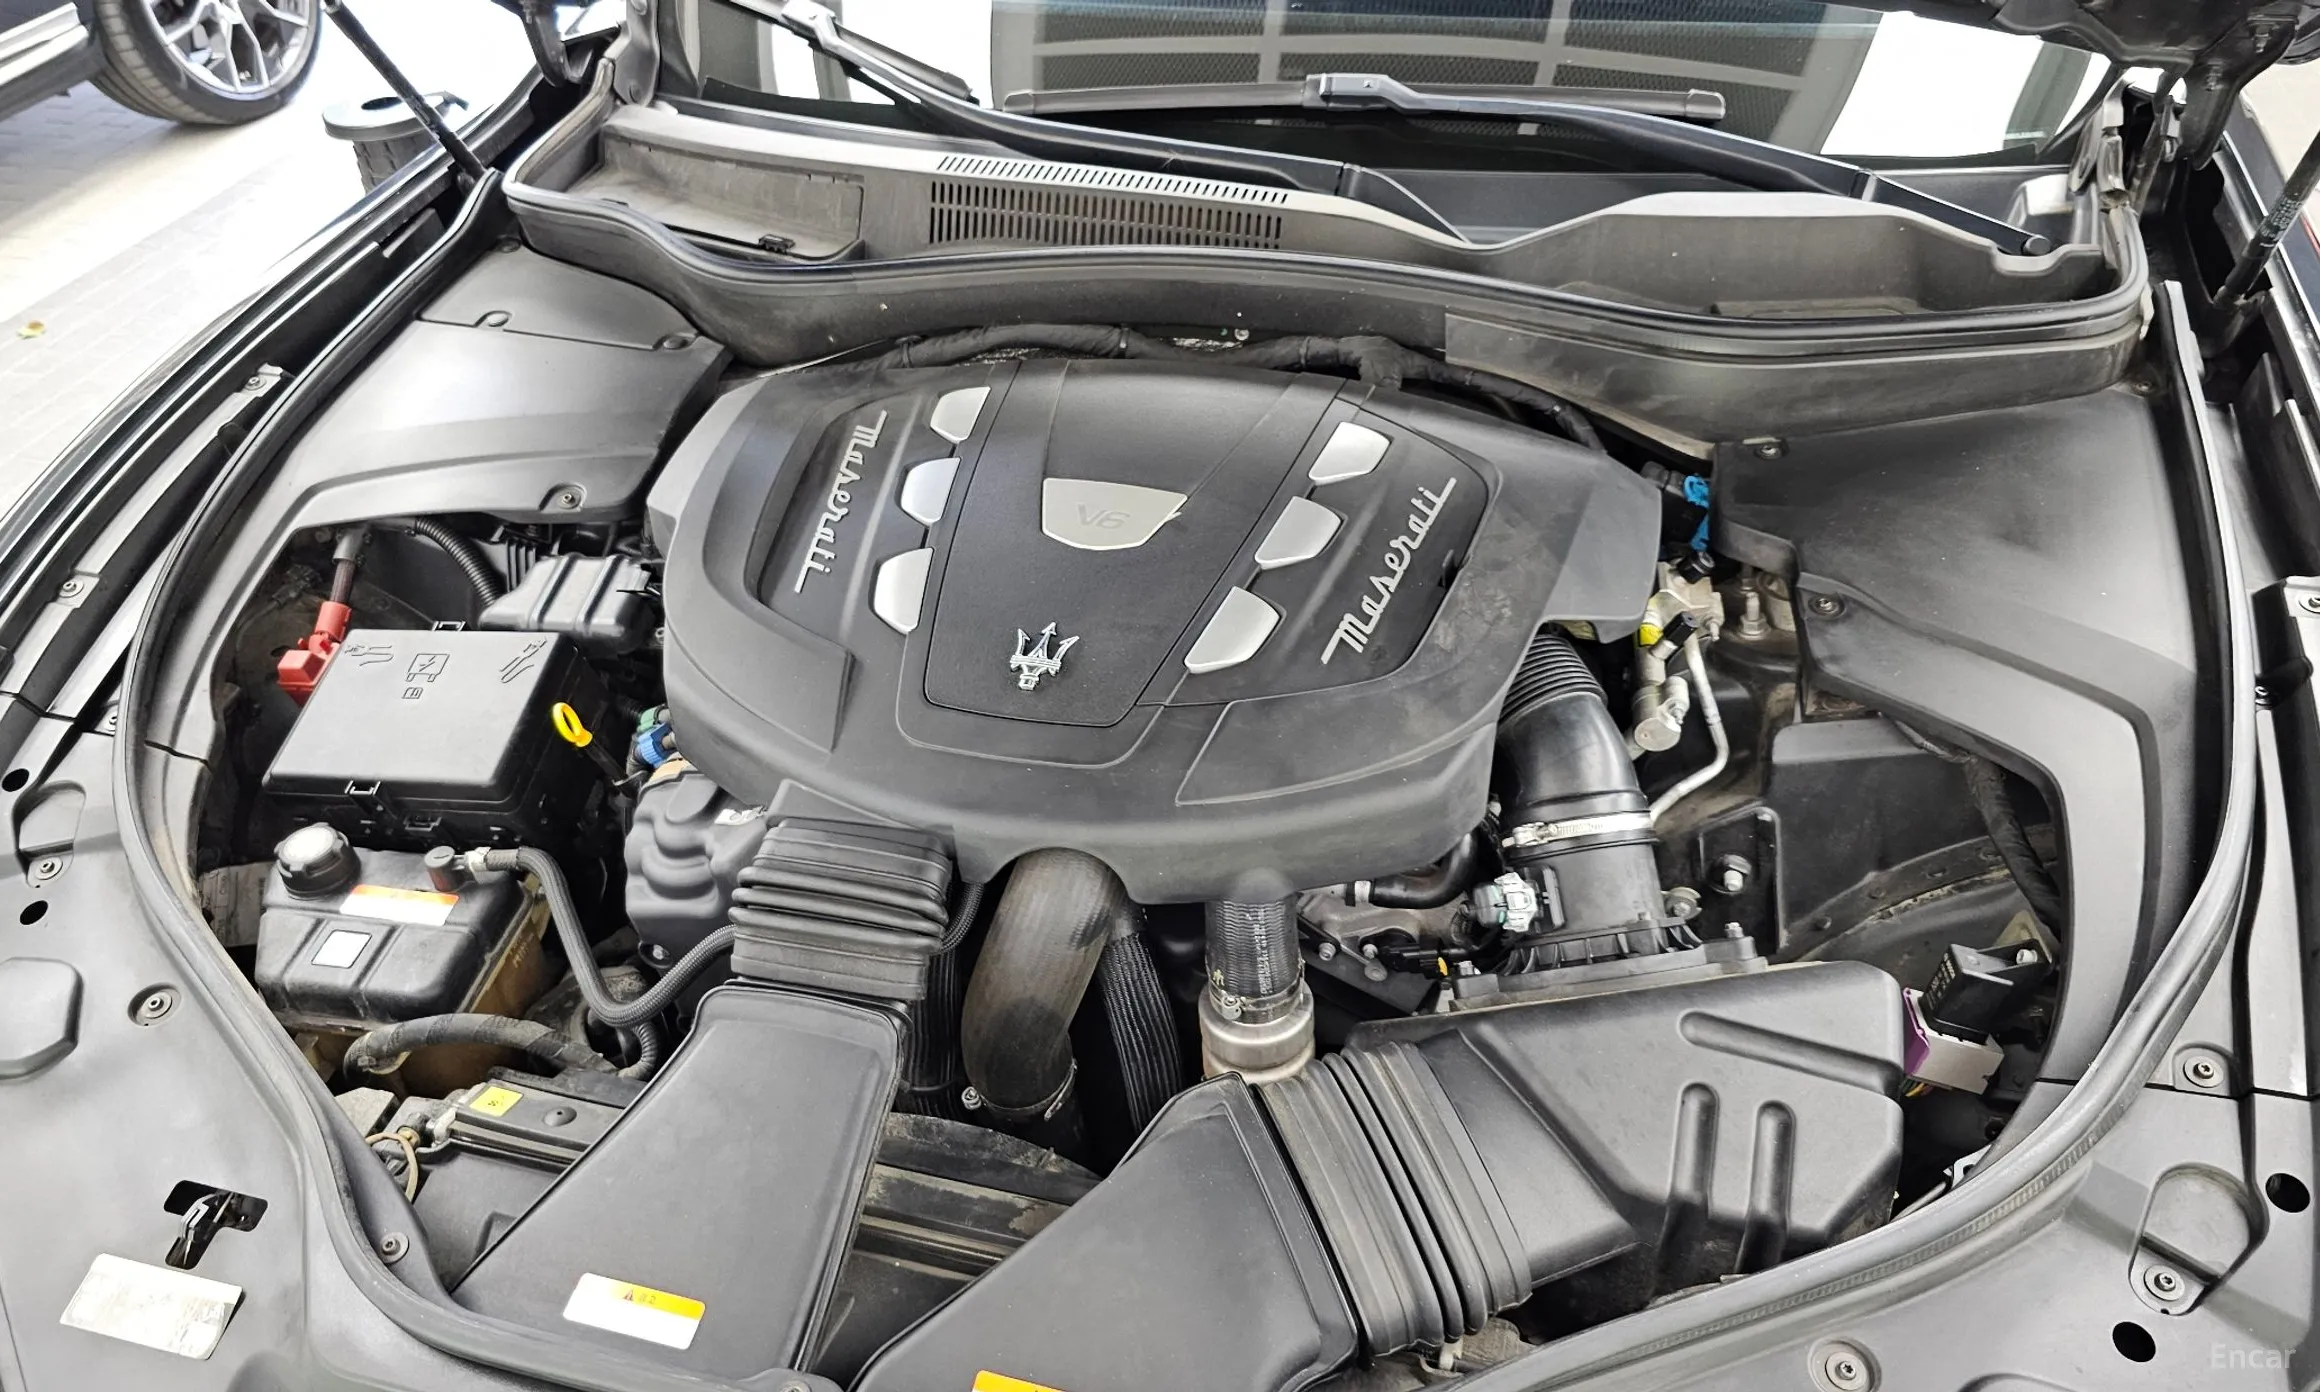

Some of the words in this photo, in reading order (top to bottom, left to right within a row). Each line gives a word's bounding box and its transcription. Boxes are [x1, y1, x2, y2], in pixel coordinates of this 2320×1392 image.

[794, 409, 887, 594] Maserati
[1077, 502, 1131, 529] V6
[1320, 476, 1457, 665] Maserati
